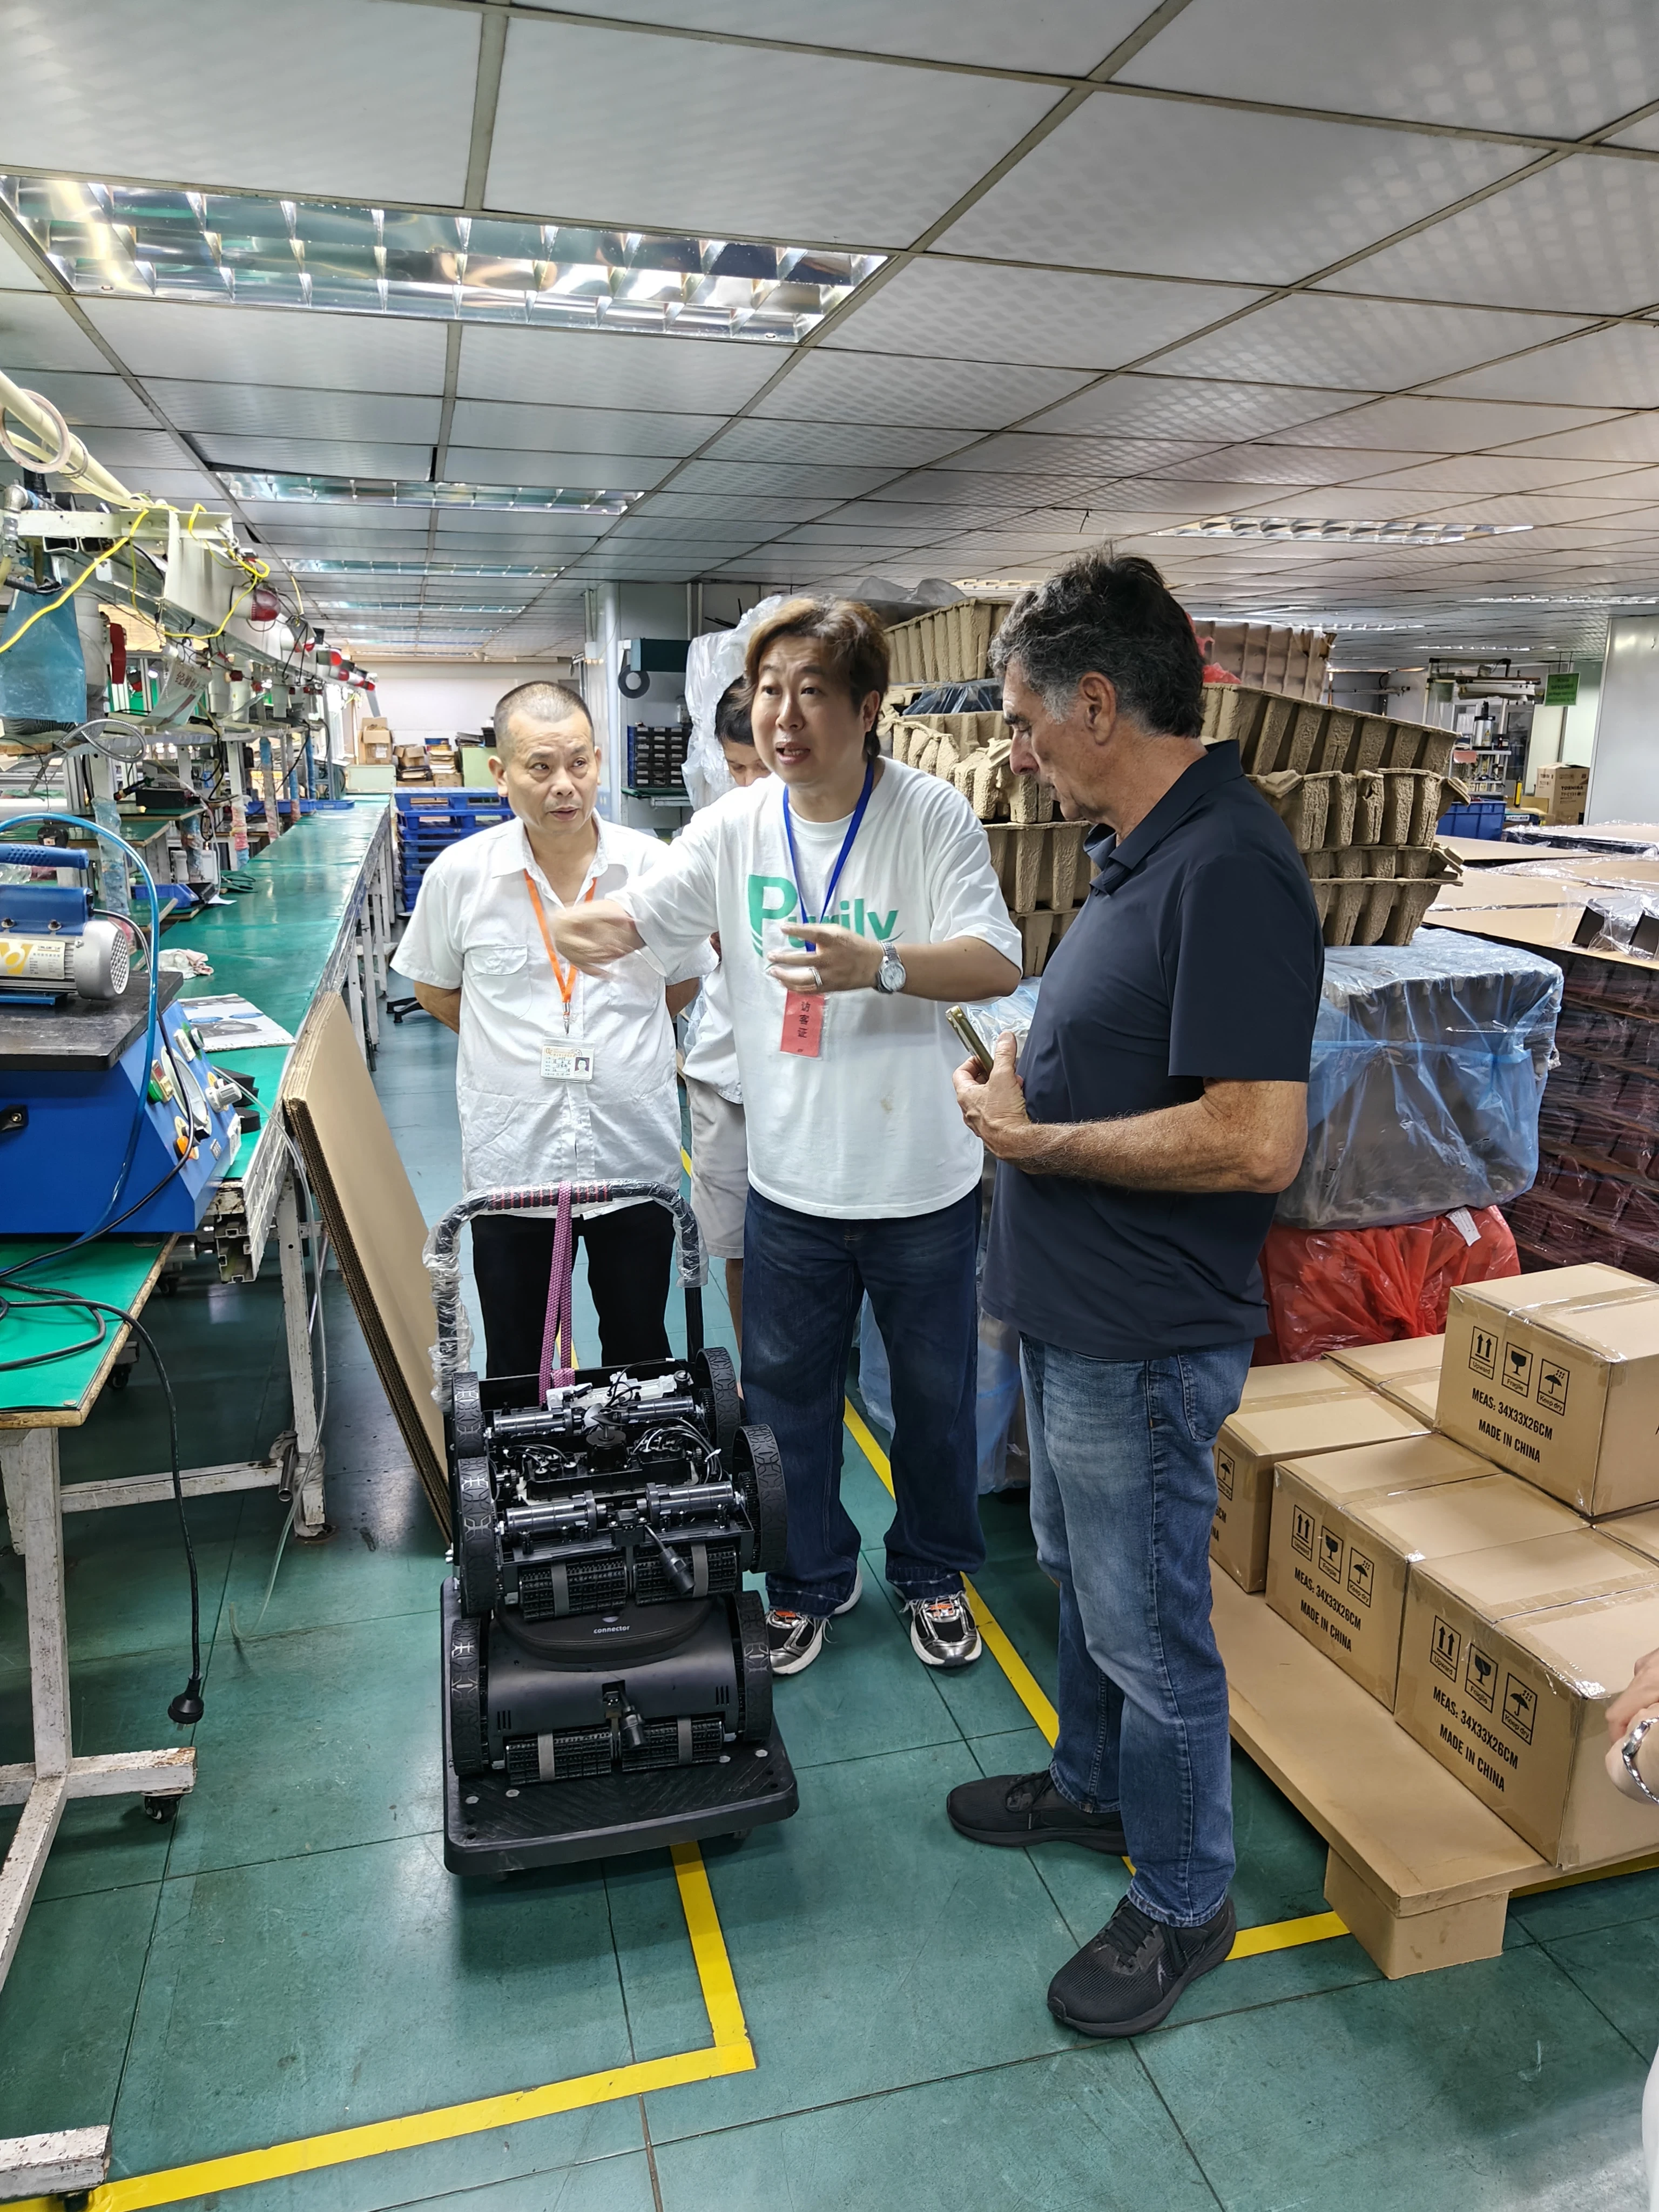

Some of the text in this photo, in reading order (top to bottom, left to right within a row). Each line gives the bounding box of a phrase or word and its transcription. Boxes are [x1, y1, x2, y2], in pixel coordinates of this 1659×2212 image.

[1472, 1388, 1553, 1440] MEAS: 34X33X26CM
[1554, 1402, 1562, 1412] dry
[1479, 1419, 1540, 1463] MADE IN CHINA
[1294, 1567, 1361, 1631] MEAS: 34X33X26CM
[593, 1626, 630, 1634] connector
[1300, 1599, 1352, 1653] MADE IN CHINA
[1434, 1655, 1453, 1675] Upward
[1433, 1686, 1519, 1770] MEAS: 34X33X26CM
[1520, 1728, 1529, 1739] dry
[1440, 1724, 1505, 1792] MADE IN CHINA
